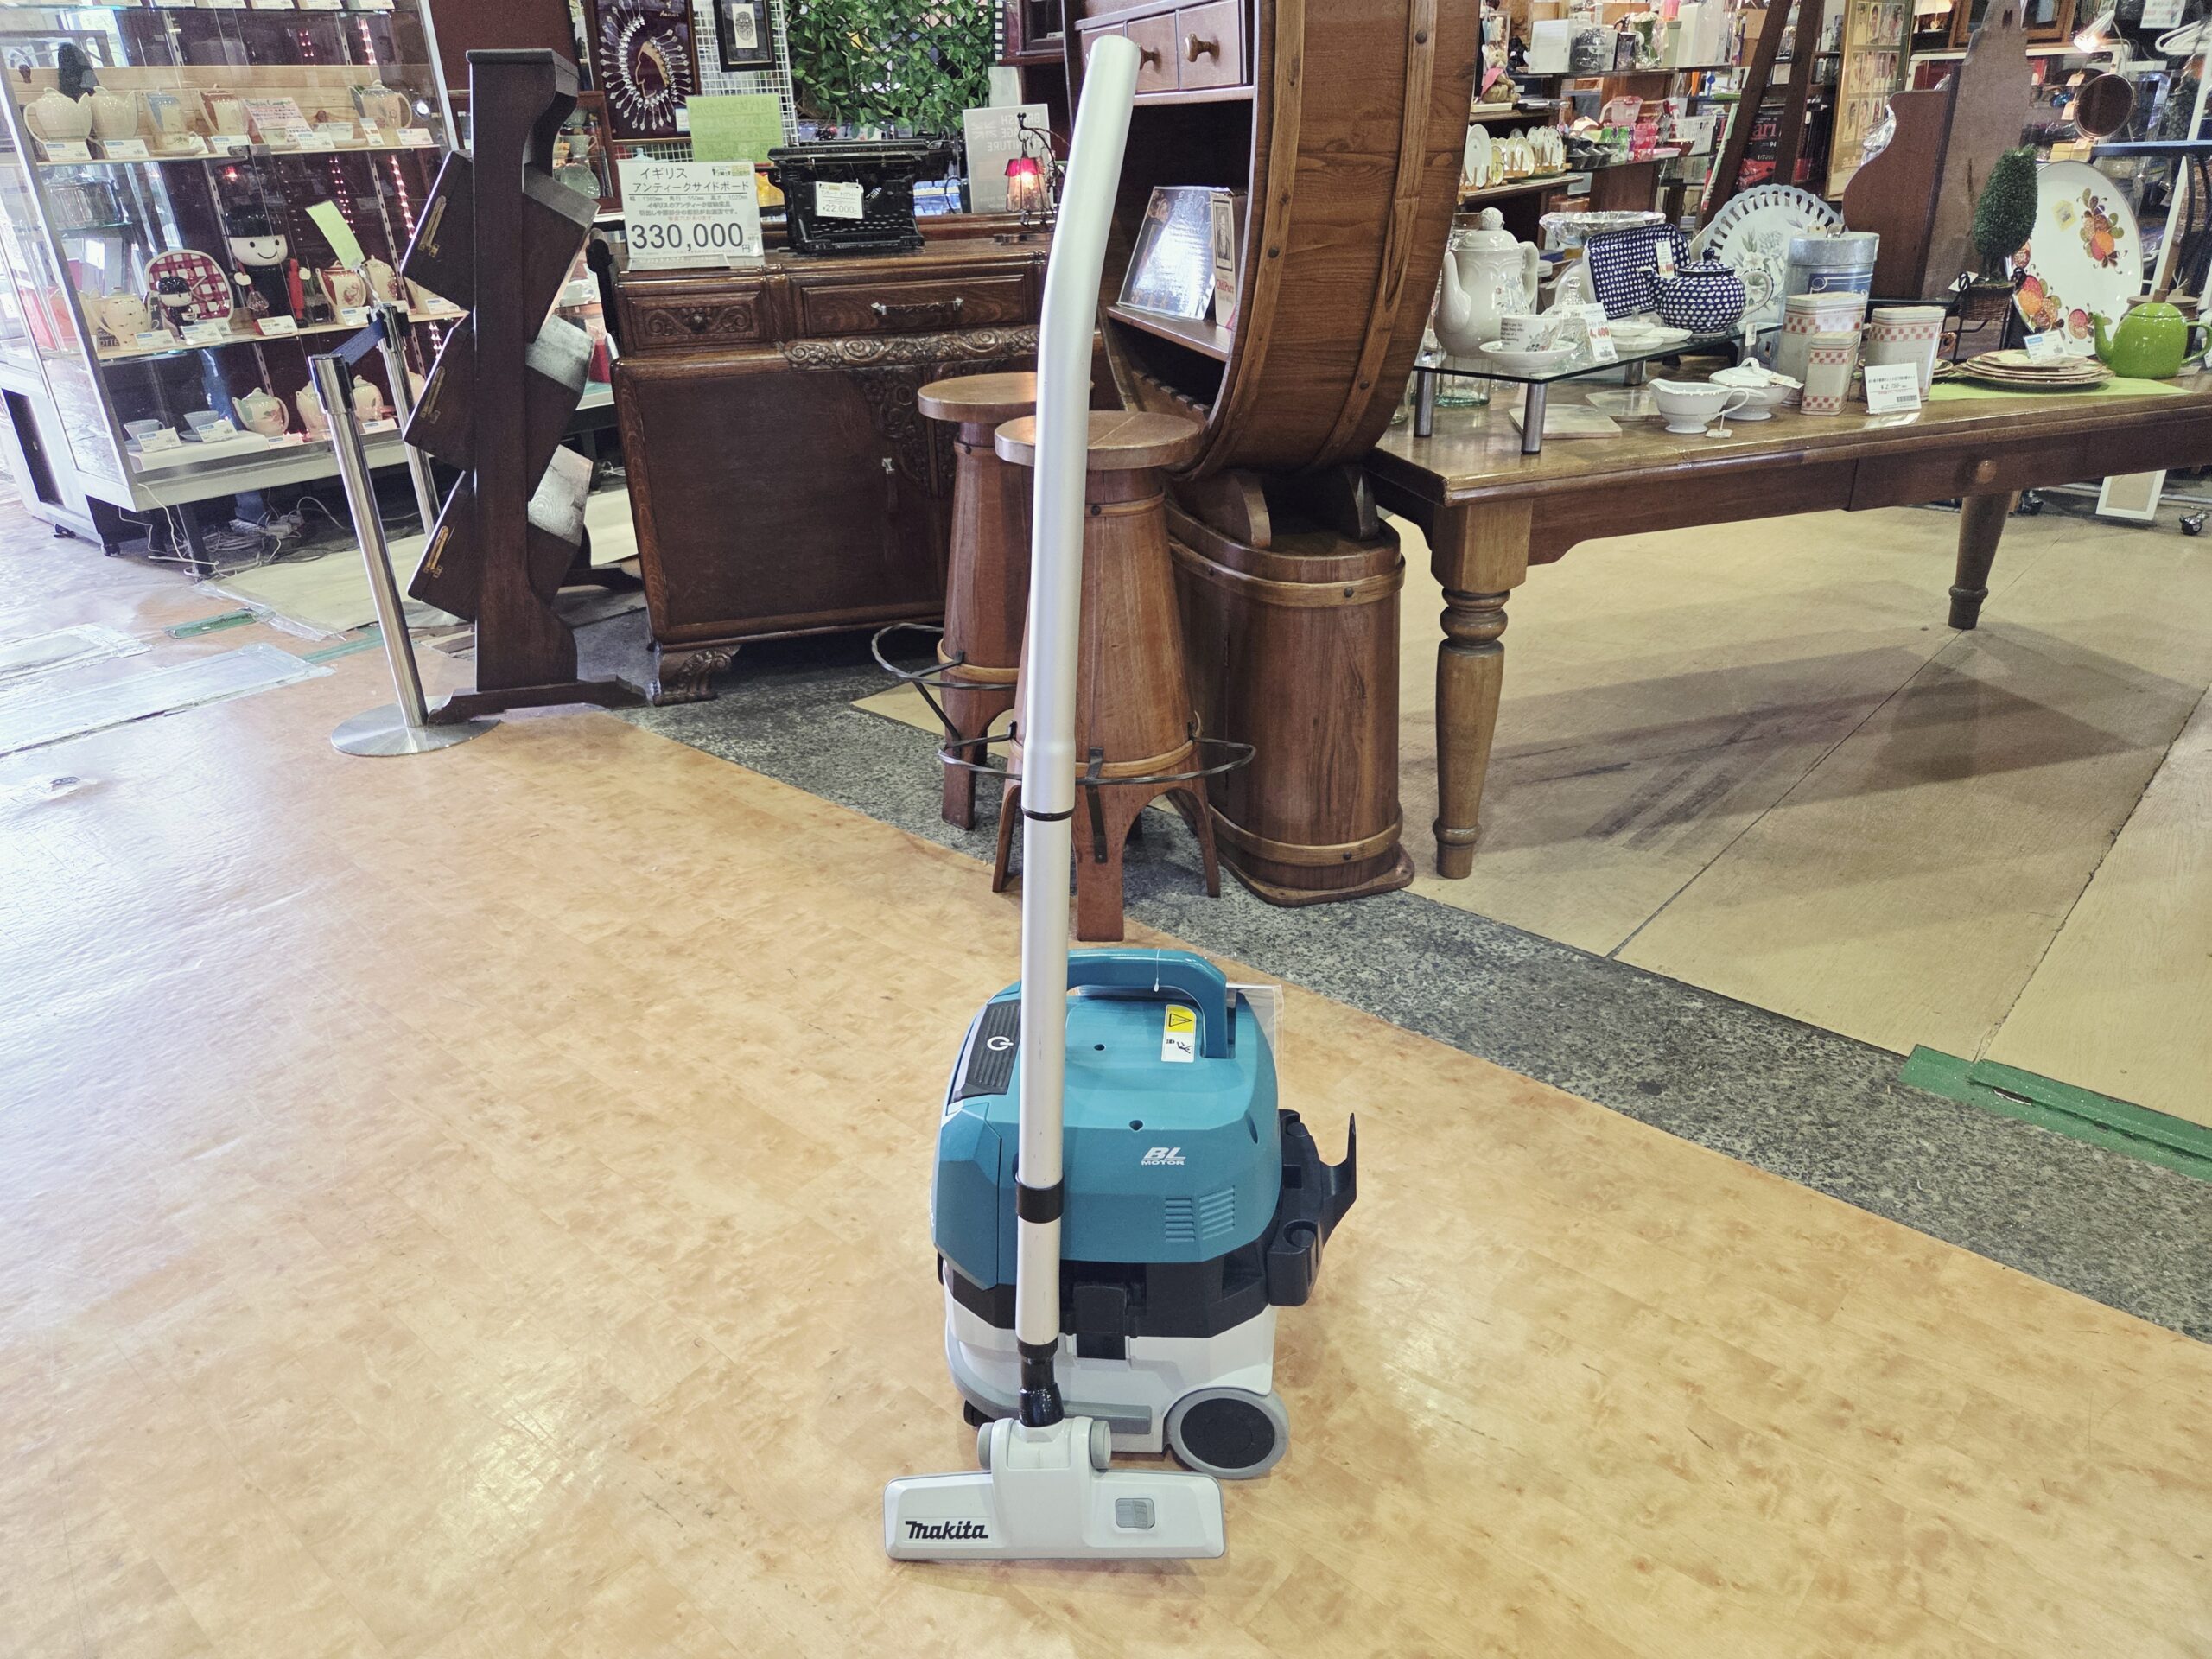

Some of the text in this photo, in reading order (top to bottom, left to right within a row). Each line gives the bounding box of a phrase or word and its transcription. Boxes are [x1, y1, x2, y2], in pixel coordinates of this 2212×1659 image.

[640, 168, 688, 180] イギリス
[632, 181, 749, 193] アンティークサイドボード
[1142, 1147, 1186, 1161] BL
